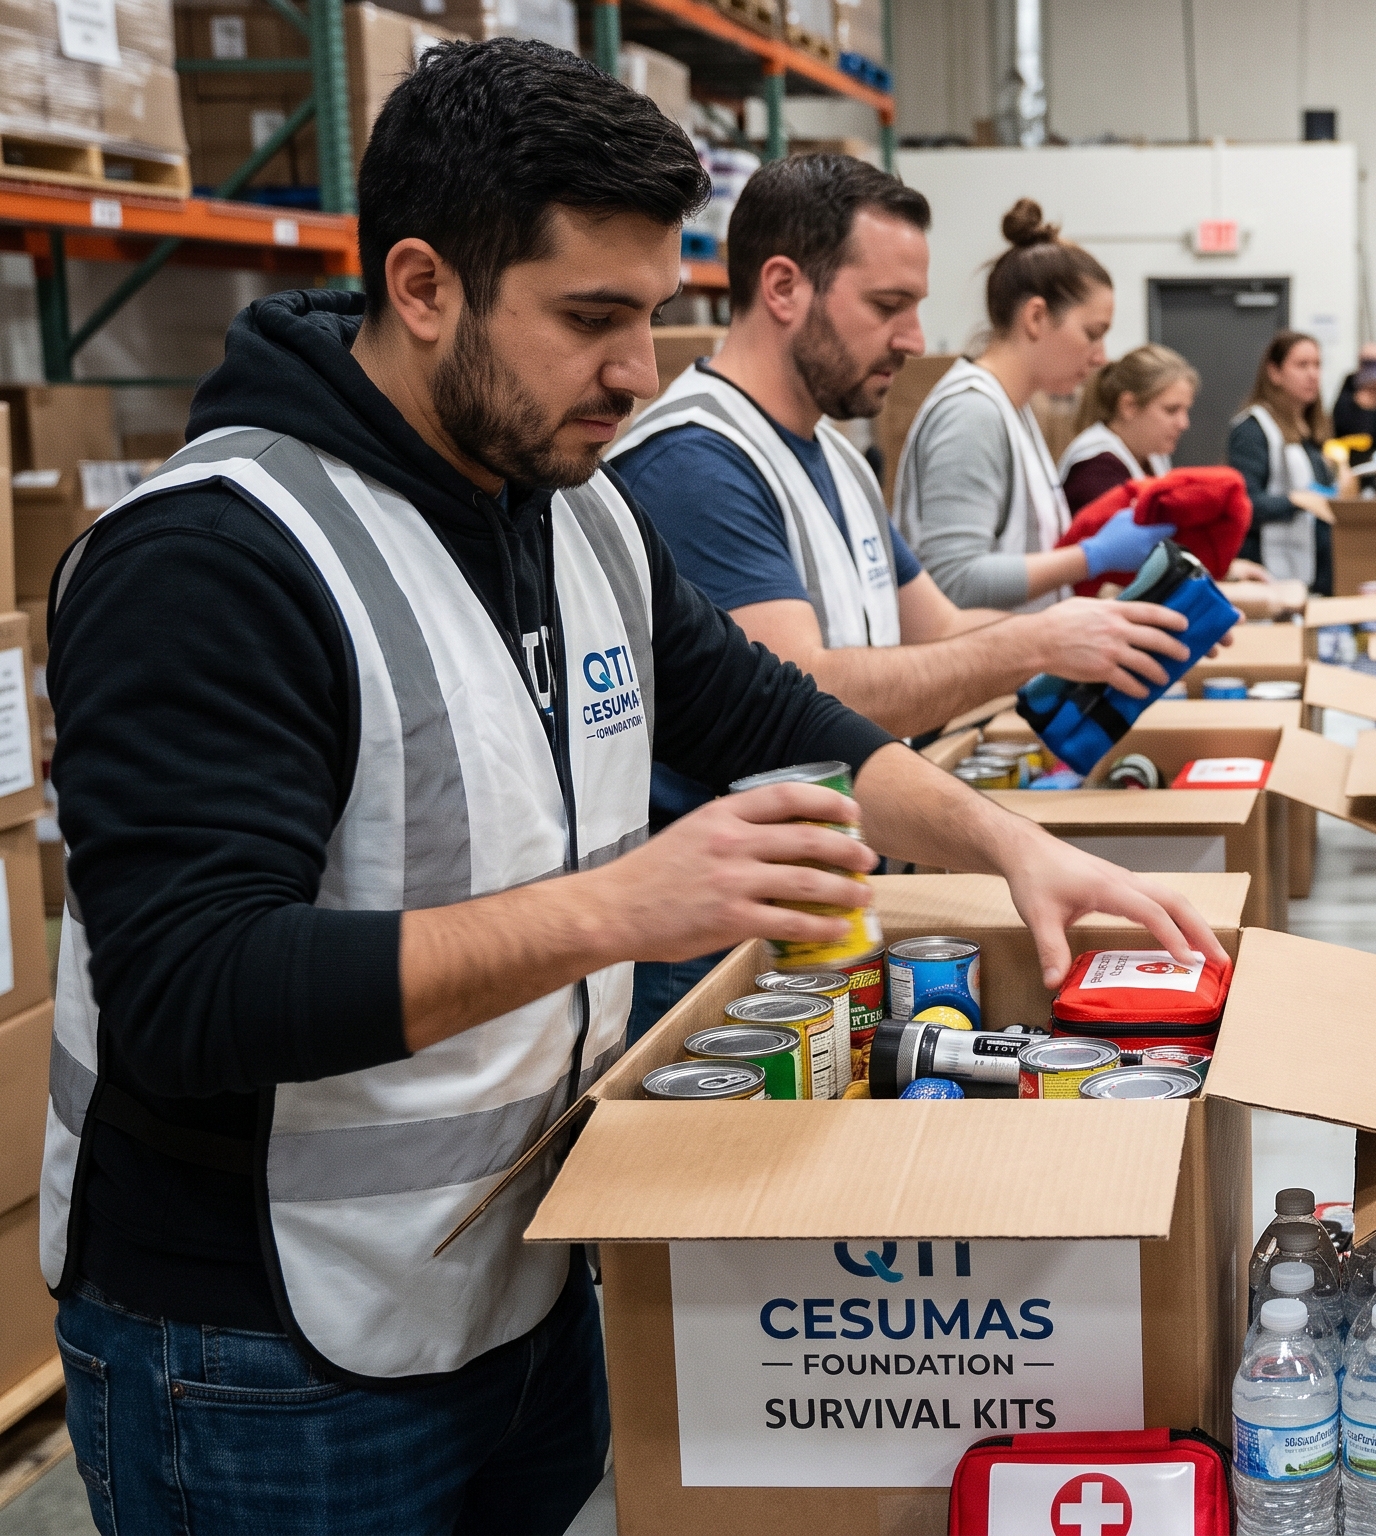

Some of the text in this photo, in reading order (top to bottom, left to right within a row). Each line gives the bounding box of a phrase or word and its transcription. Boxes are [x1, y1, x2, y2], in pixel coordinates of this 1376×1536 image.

[583, 645, 633, 693] QTI
[583, 688, 640, 725] CESUMA
[760, 1298, 1054, 1340] CESUMAS
[804, 1354, 1014, 1375] FOUNDATION
[765, 1398, 1057, 1429] SURVIVAL KITS
